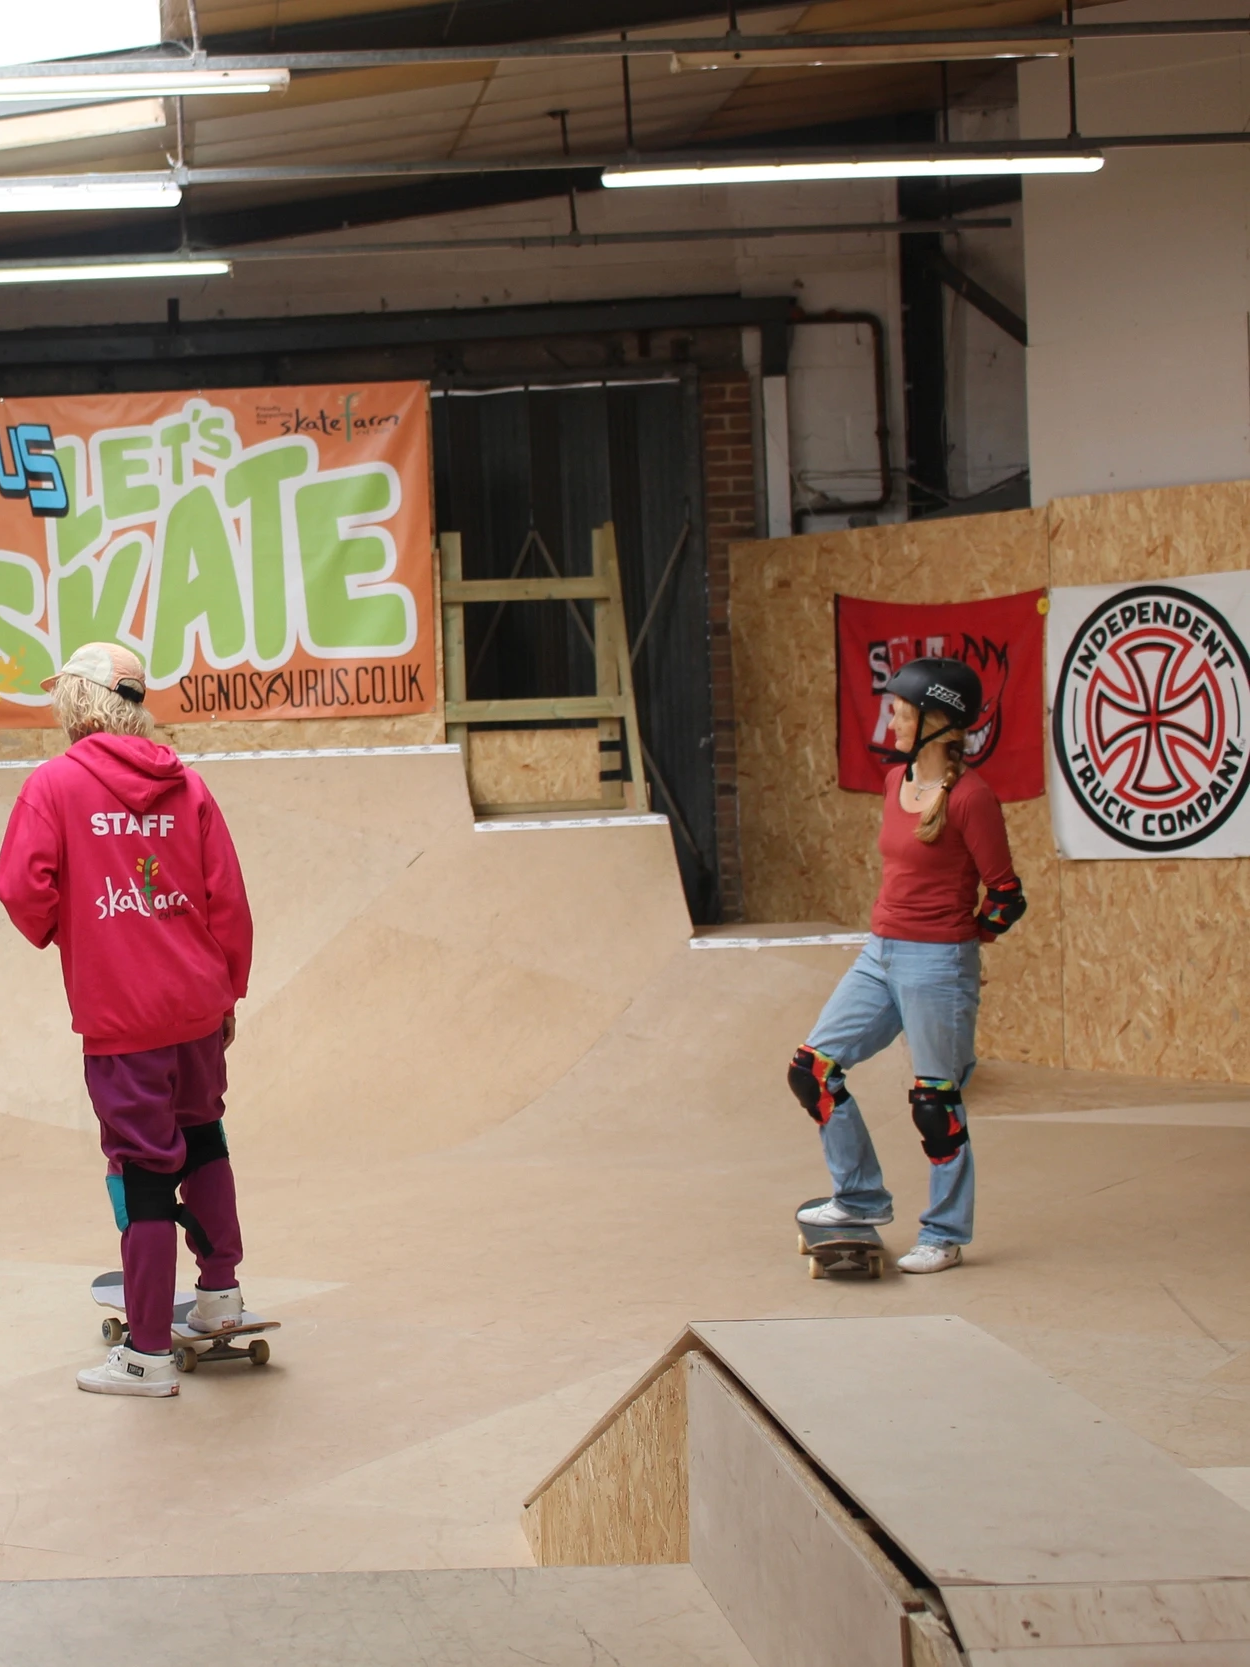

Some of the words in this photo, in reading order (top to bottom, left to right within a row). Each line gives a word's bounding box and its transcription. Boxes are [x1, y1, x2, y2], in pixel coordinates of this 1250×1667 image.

[45, 406, 234, 567] LET'S
[1072, 600, 1236, 681] INDEPENDENT
[90, 812, 175, 837] STAFF
[1070, 743, 1136, 831] TRUCK
[1141, 737, 1244, 837] COMPANY
[95, 853, 194, 920] skatfar
